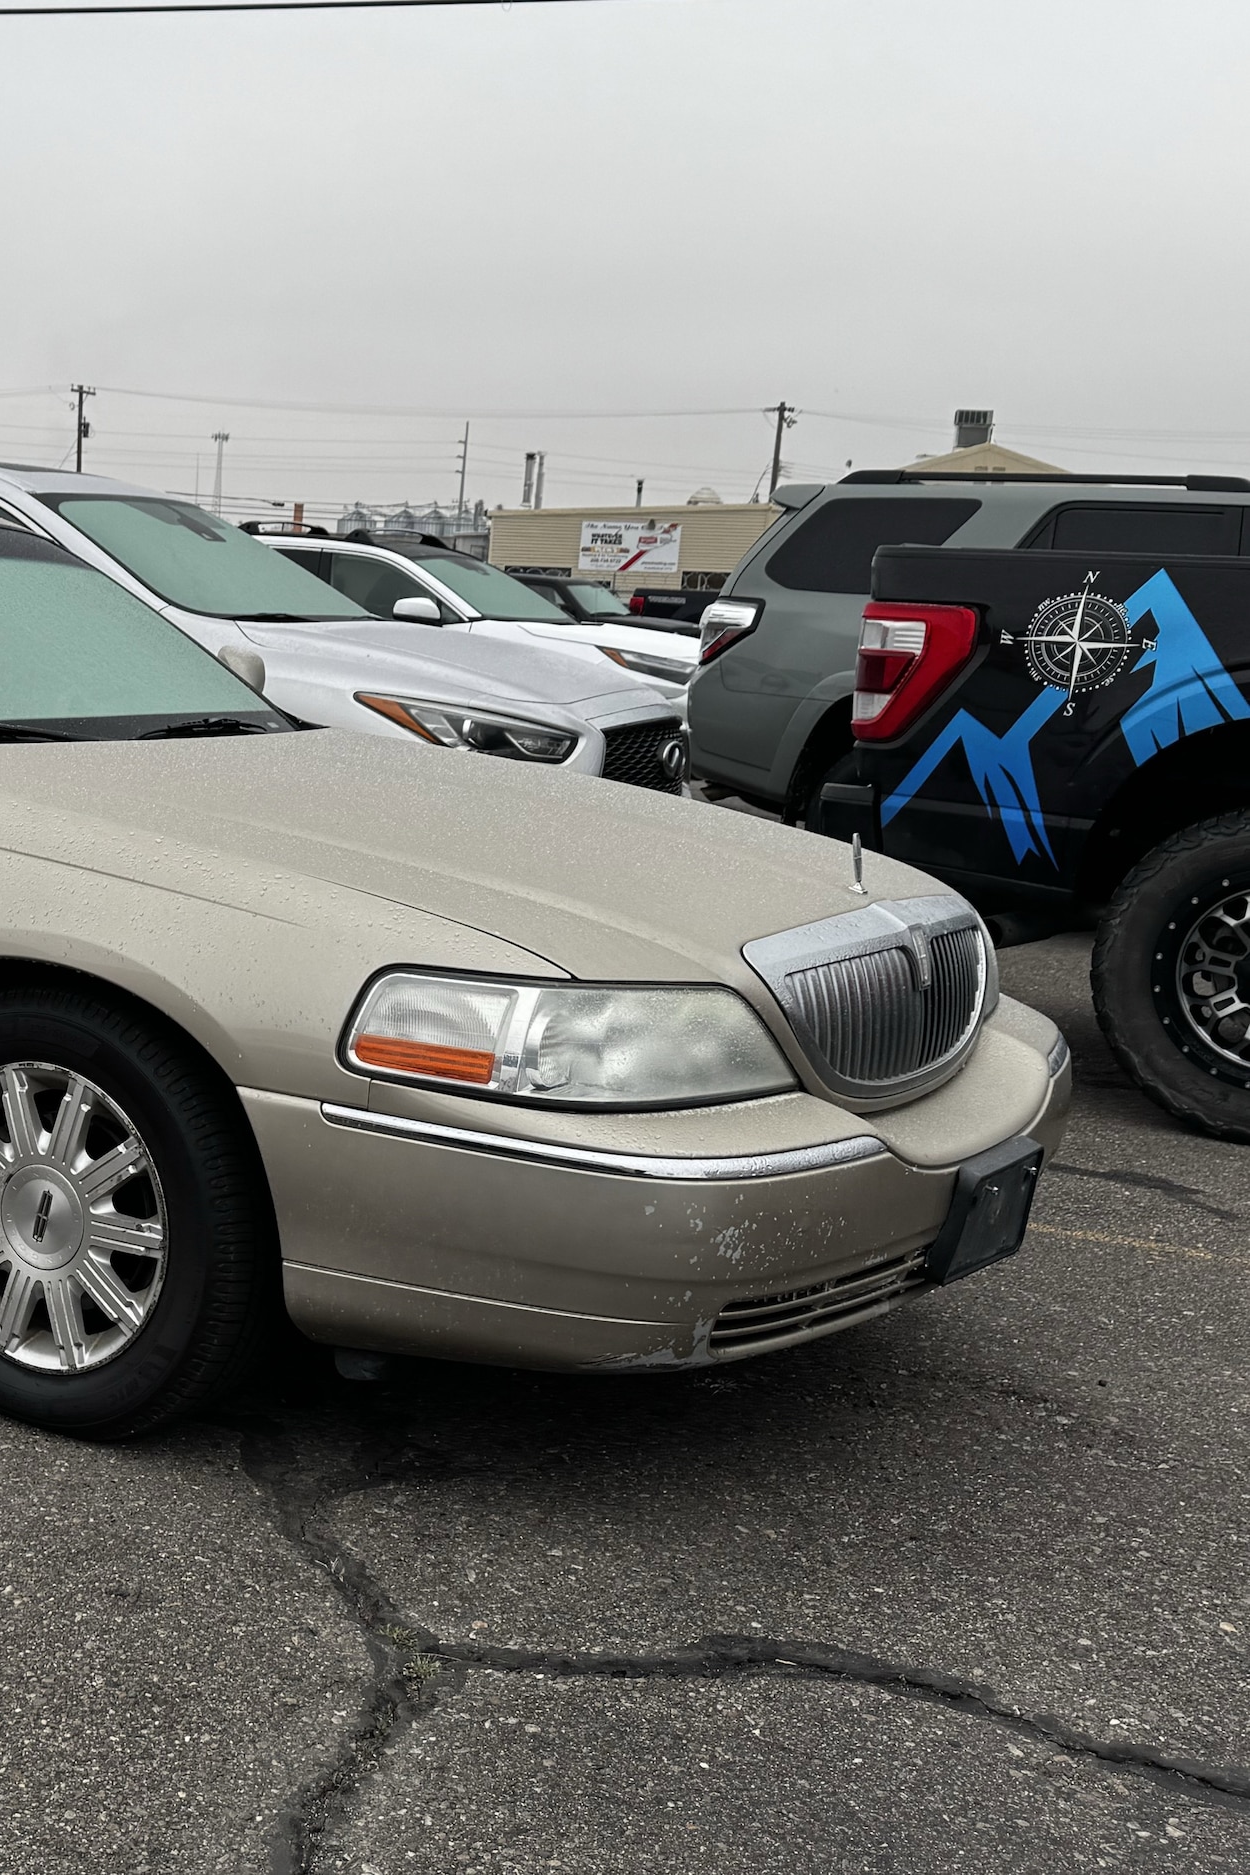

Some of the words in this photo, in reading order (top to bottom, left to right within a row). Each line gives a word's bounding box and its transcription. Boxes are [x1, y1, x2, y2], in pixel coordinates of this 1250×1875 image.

[1082, 571, 1101, 584] N
[1000, 629, 1015, 645] W
[1142, 638, 1157, 652] E
[1063, 702, 1075, 717] S
